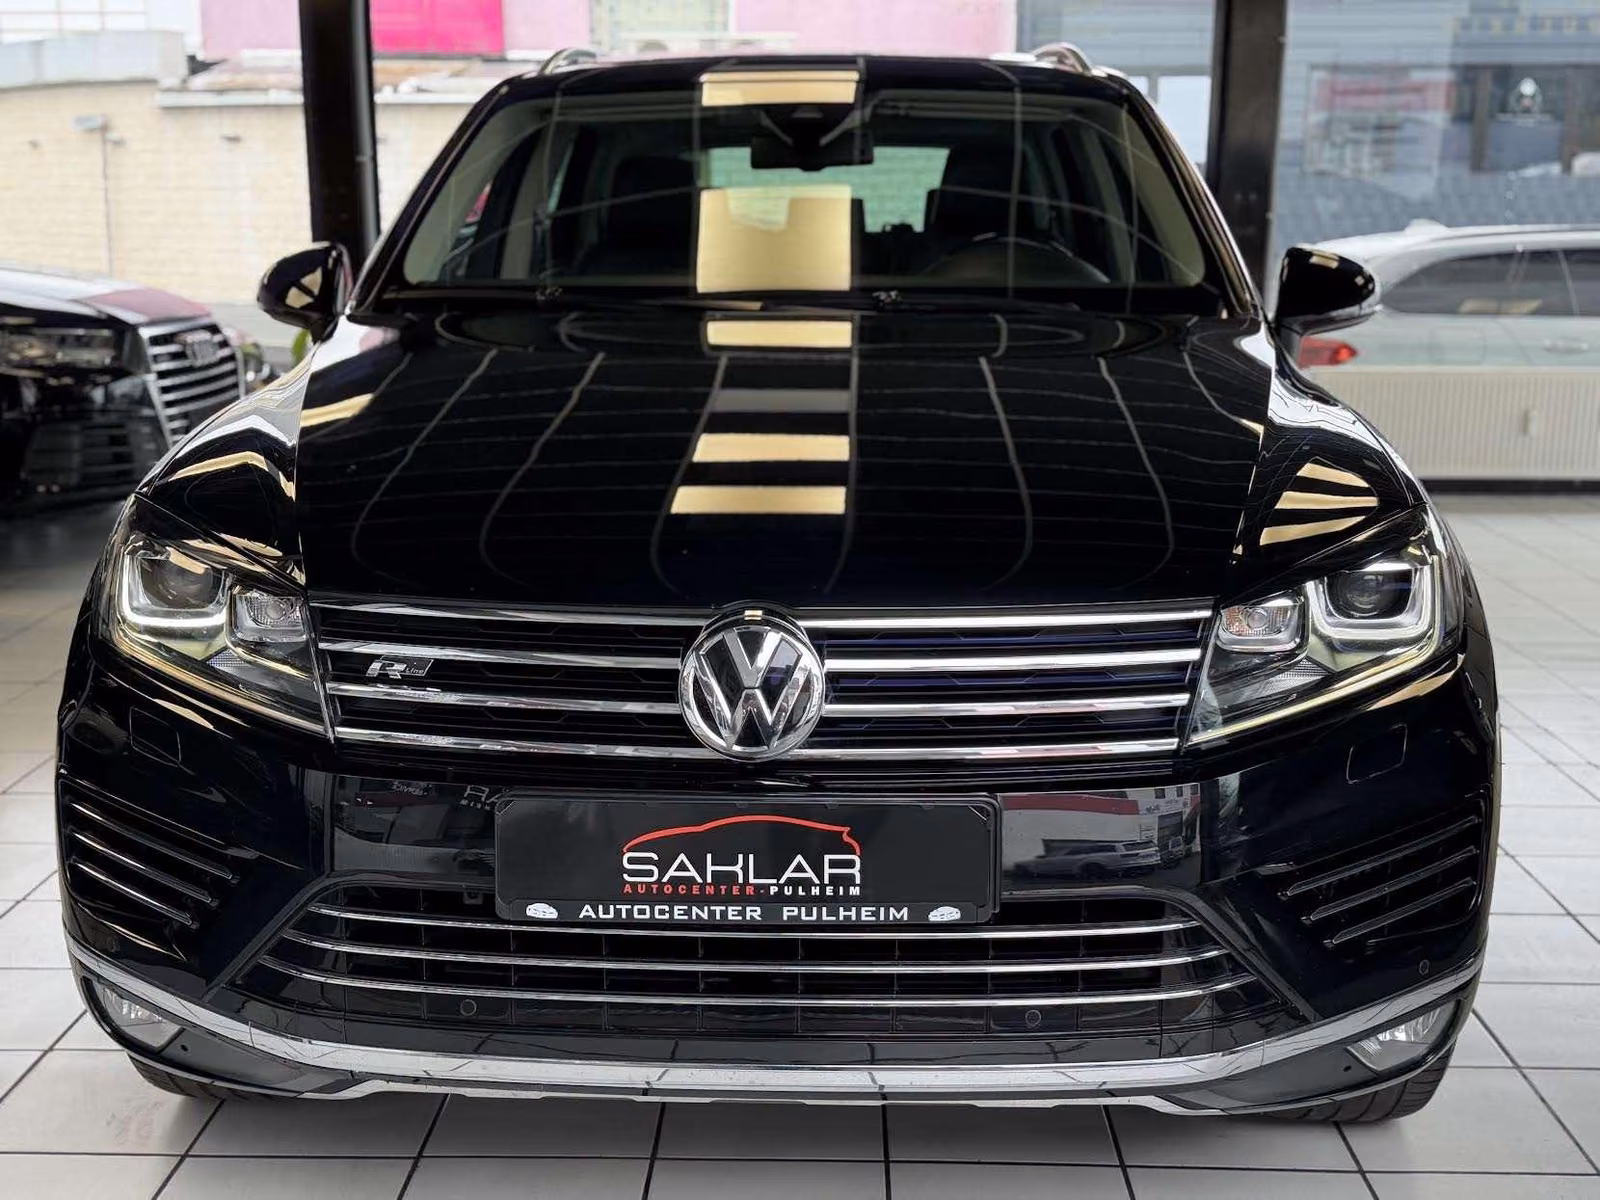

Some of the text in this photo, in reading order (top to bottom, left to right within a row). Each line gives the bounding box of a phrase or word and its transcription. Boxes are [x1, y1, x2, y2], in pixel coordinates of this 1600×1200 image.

[622, 851, 861, 884] SAHLAR
[578, 903, 909, 921] AUTOCENTER PULHEIM
